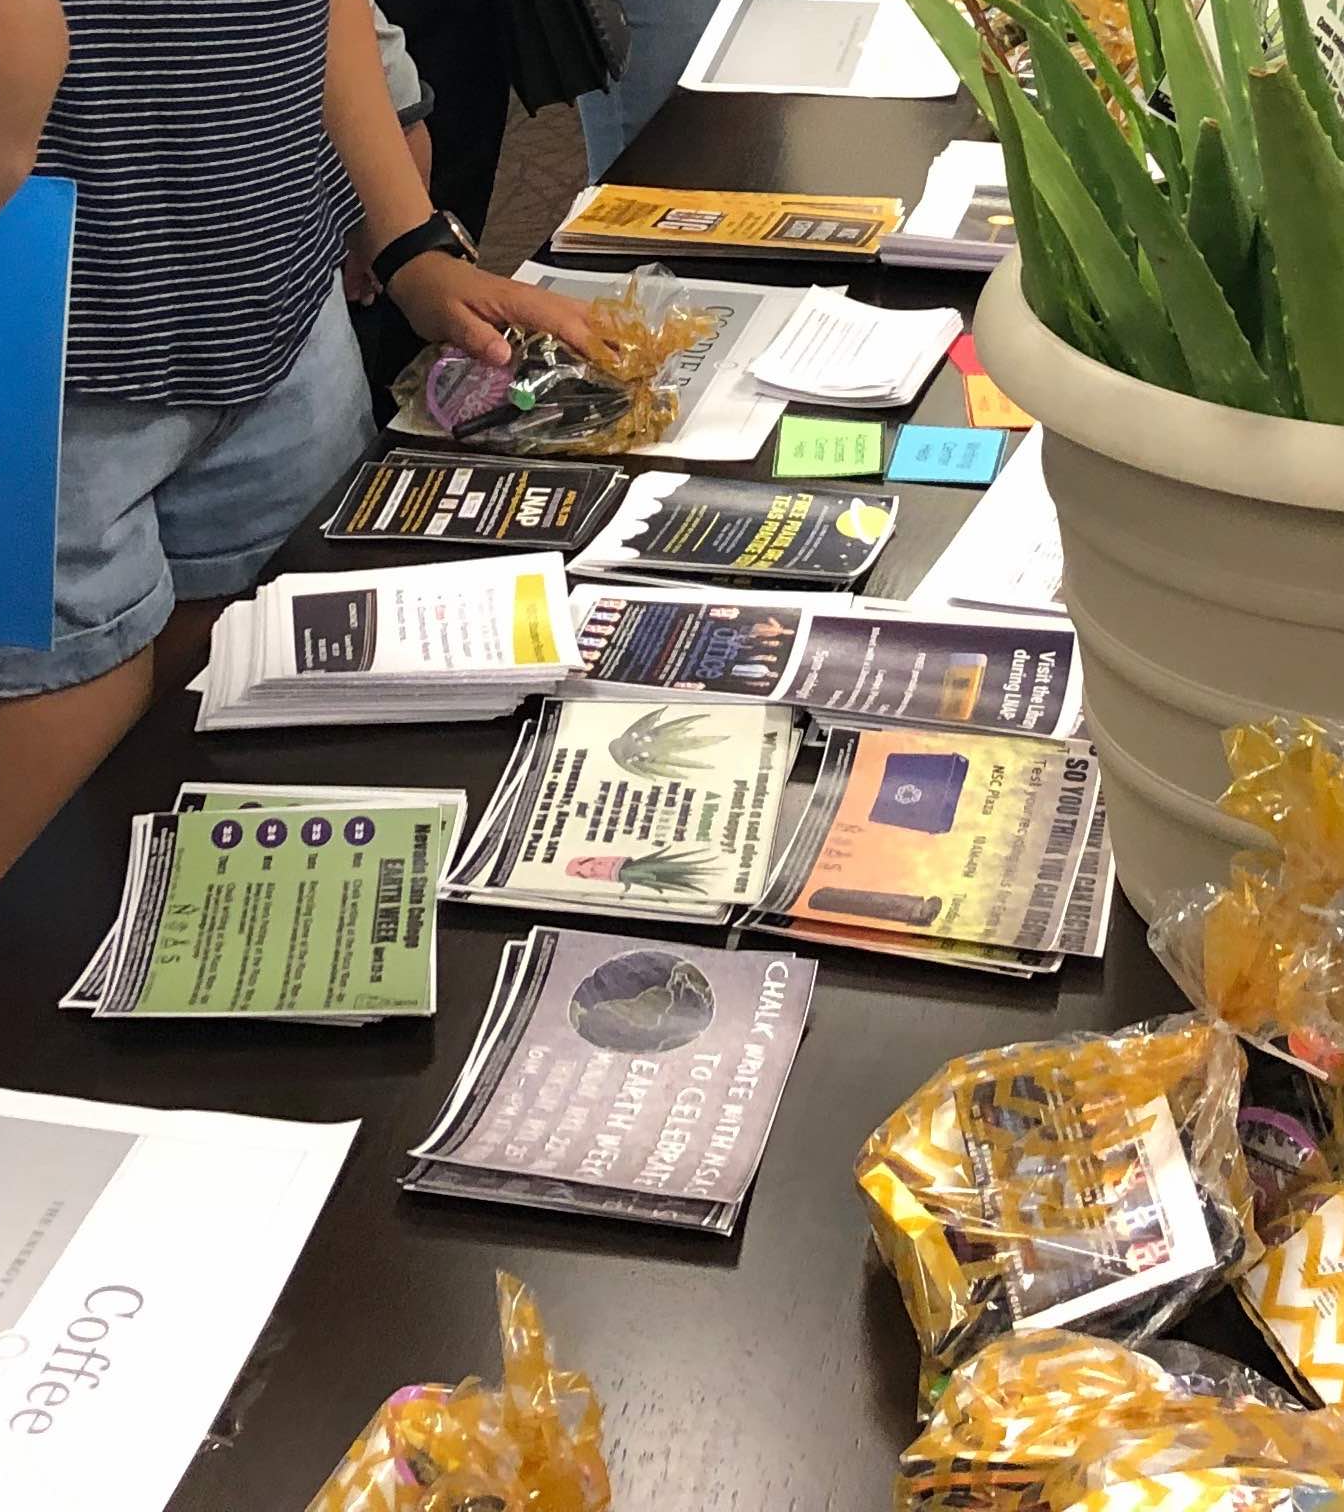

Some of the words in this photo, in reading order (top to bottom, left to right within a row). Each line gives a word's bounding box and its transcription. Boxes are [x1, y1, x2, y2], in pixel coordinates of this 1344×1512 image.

[516, 487, 552, 527] LNAP
[766, 495, 793, 520] TEAS
[789, 493, 815, 519] FREE
[1002, 649, 1031, 692] during
[1033, 651, 1056, 684] Visit
[1030, 685, 1051, 703] the
[759, 731, 778, 771] What
[989, 764, 1006, 786] NSC
[1029, 759, 1048, 786] Test
[1063, 758, 1090, 782] SO
[705, 790, 722, 801] A
[731, 779, 750, 810] plant
[751, 772, 770, 810] makes
[981, 789, 1002, 816] Plaza
[1054, 785, 1084, 814] YOU
[412, 824, 432, 874] Nevada
[1044, 818, 1076, 856] THINK
[379, 858, 405, 904] EARTH
[410, 876, 428, 904] State
[375, 906, 401, 943] WEEK
[403, 907, 426, 948] College
[750, 960, 789, 1040] CHALK
[690, 1052, 721, 1080] TO
[728, 1044, 765, 1100] WRITE
[605, 1059, 659, 1130] EARTH
[713, 1104, 744, 1149] WITH
[0, 1228, 46, 1286] ENERGY
[8, 1283, 144, 1436] Coffee
